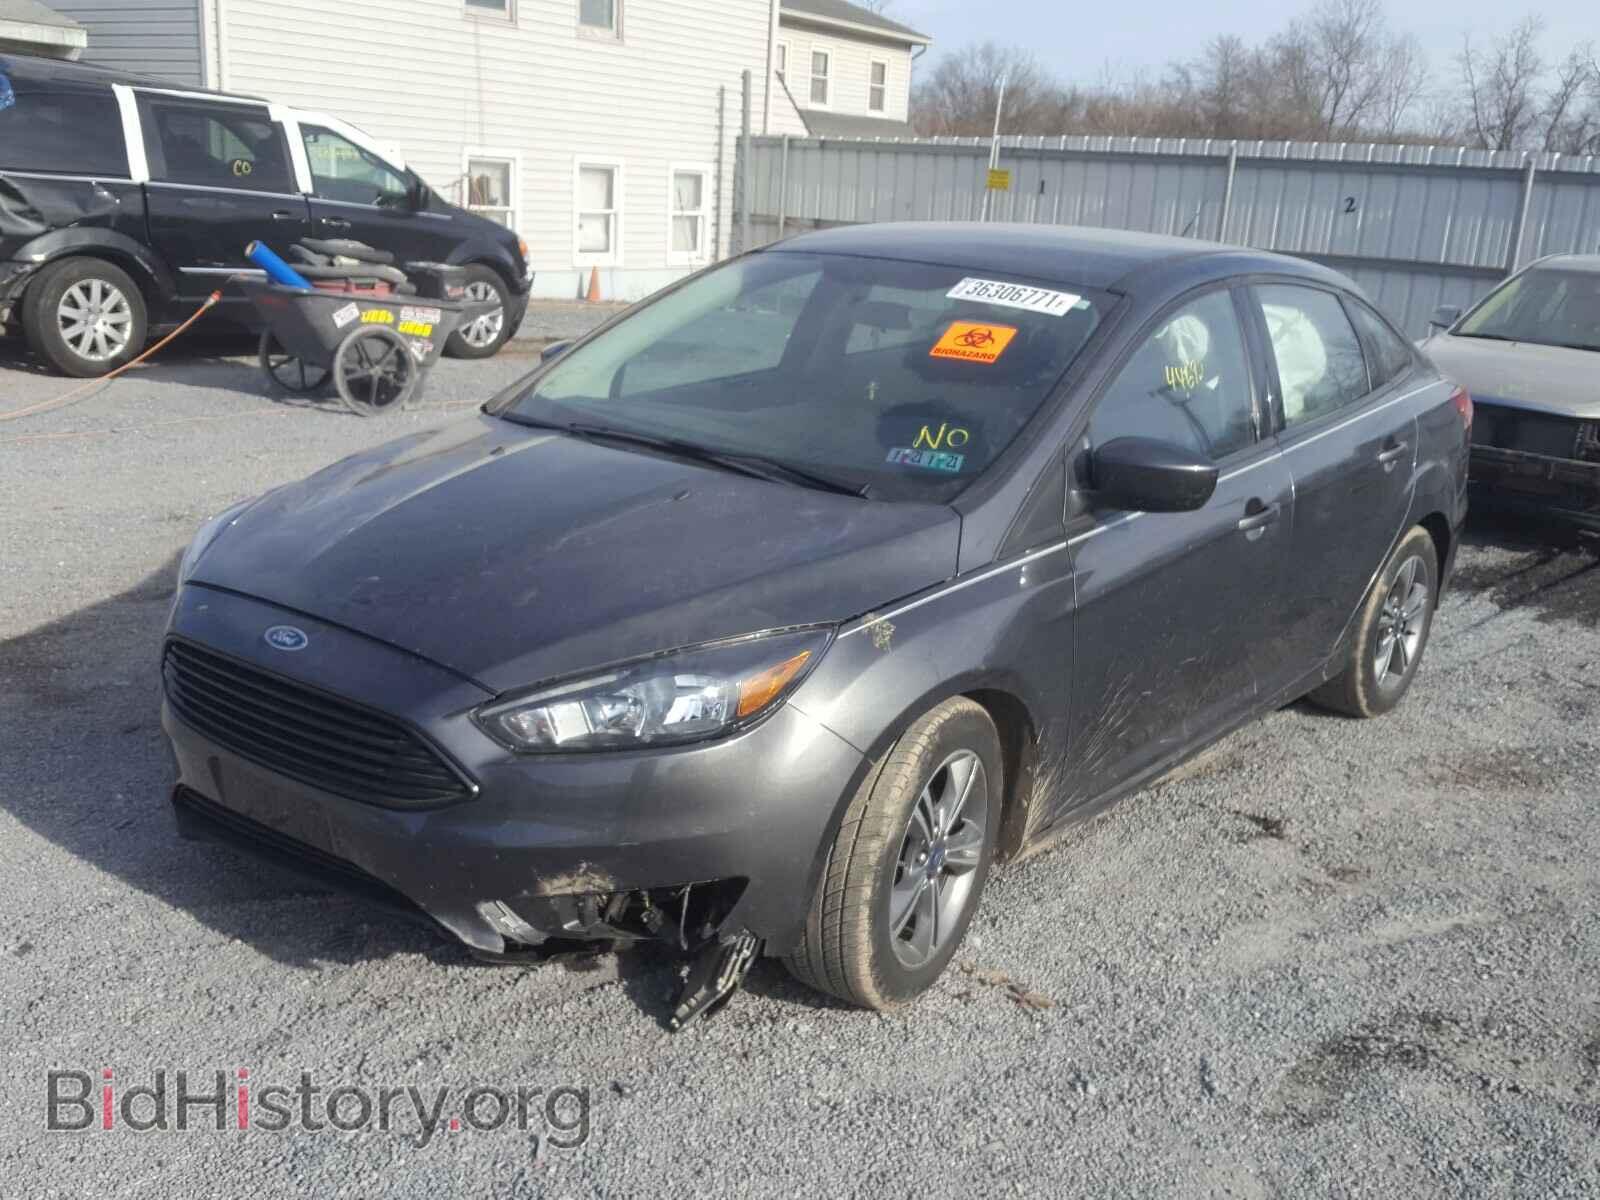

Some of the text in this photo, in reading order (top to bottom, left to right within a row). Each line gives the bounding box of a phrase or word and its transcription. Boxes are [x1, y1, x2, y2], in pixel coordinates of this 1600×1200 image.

[1344, 196, 1356, 214] 2
[965, 281, 1060, 308] 36306771
[934, 347, 996, 360] BIOHAZARD
[912, 422, 969, 449] NO
